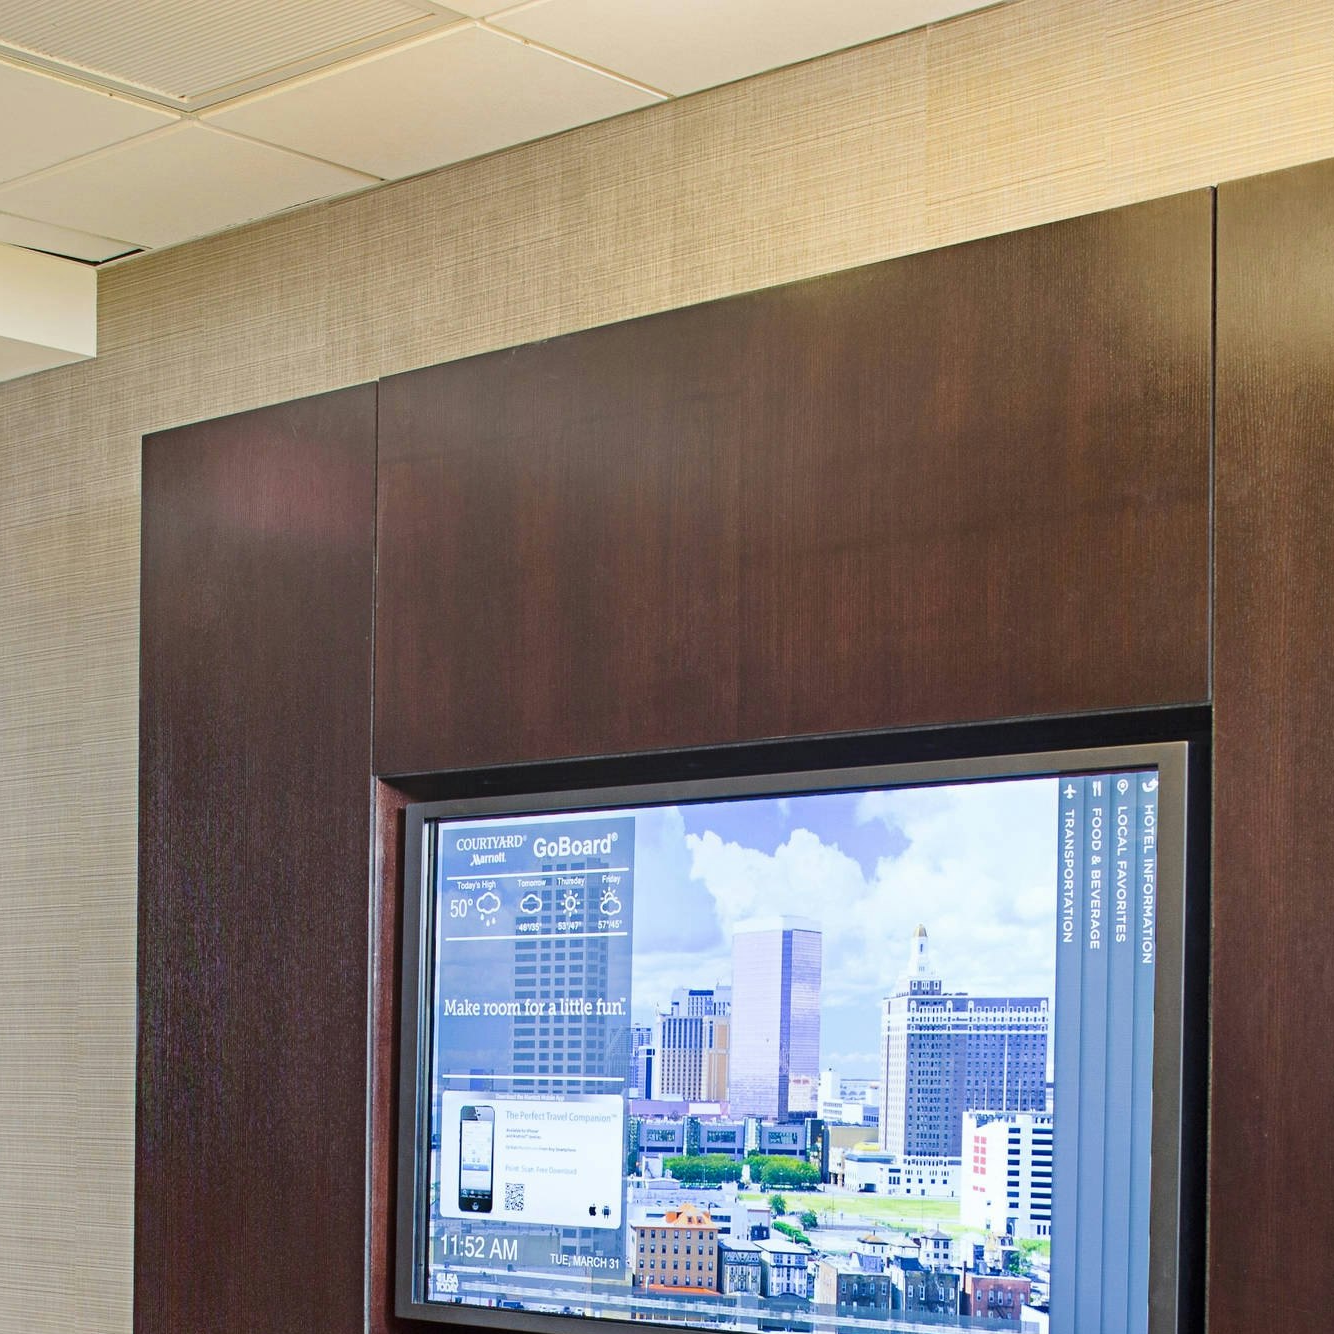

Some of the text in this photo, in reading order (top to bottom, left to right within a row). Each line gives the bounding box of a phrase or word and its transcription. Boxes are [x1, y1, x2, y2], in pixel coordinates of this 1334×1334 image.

[457, 880, 497, 891] Today's High
[517, 875, 621, 887] Tomorrow Thursday Friday
[1063, 809, 1075, 943] TRANSPORTATION
[1090, 807, 1102, 949] FOOD & BEVERAGE
[1116, 806, 1128, 942] LOCAL FAVORITES
[1142, 804, 1155, 964] HOTEL INFORMATION
[443, 999, 480, 1016] Make
[483, 1002, 521, 1016] room
[524, 999, 546, 1016] for
[548, 1003, 557, 1016] a
[560, 998, 593, 1016] little
[506, 1110, 520, 1120] The
[520, 1111, 545, 1121] Perfect
[546, 1112, 567, 1121] Travel
[441, 1233, 518, 1261] 11:52 AM
[550, 1253, 620, 1270] TUE, MARCH 31
